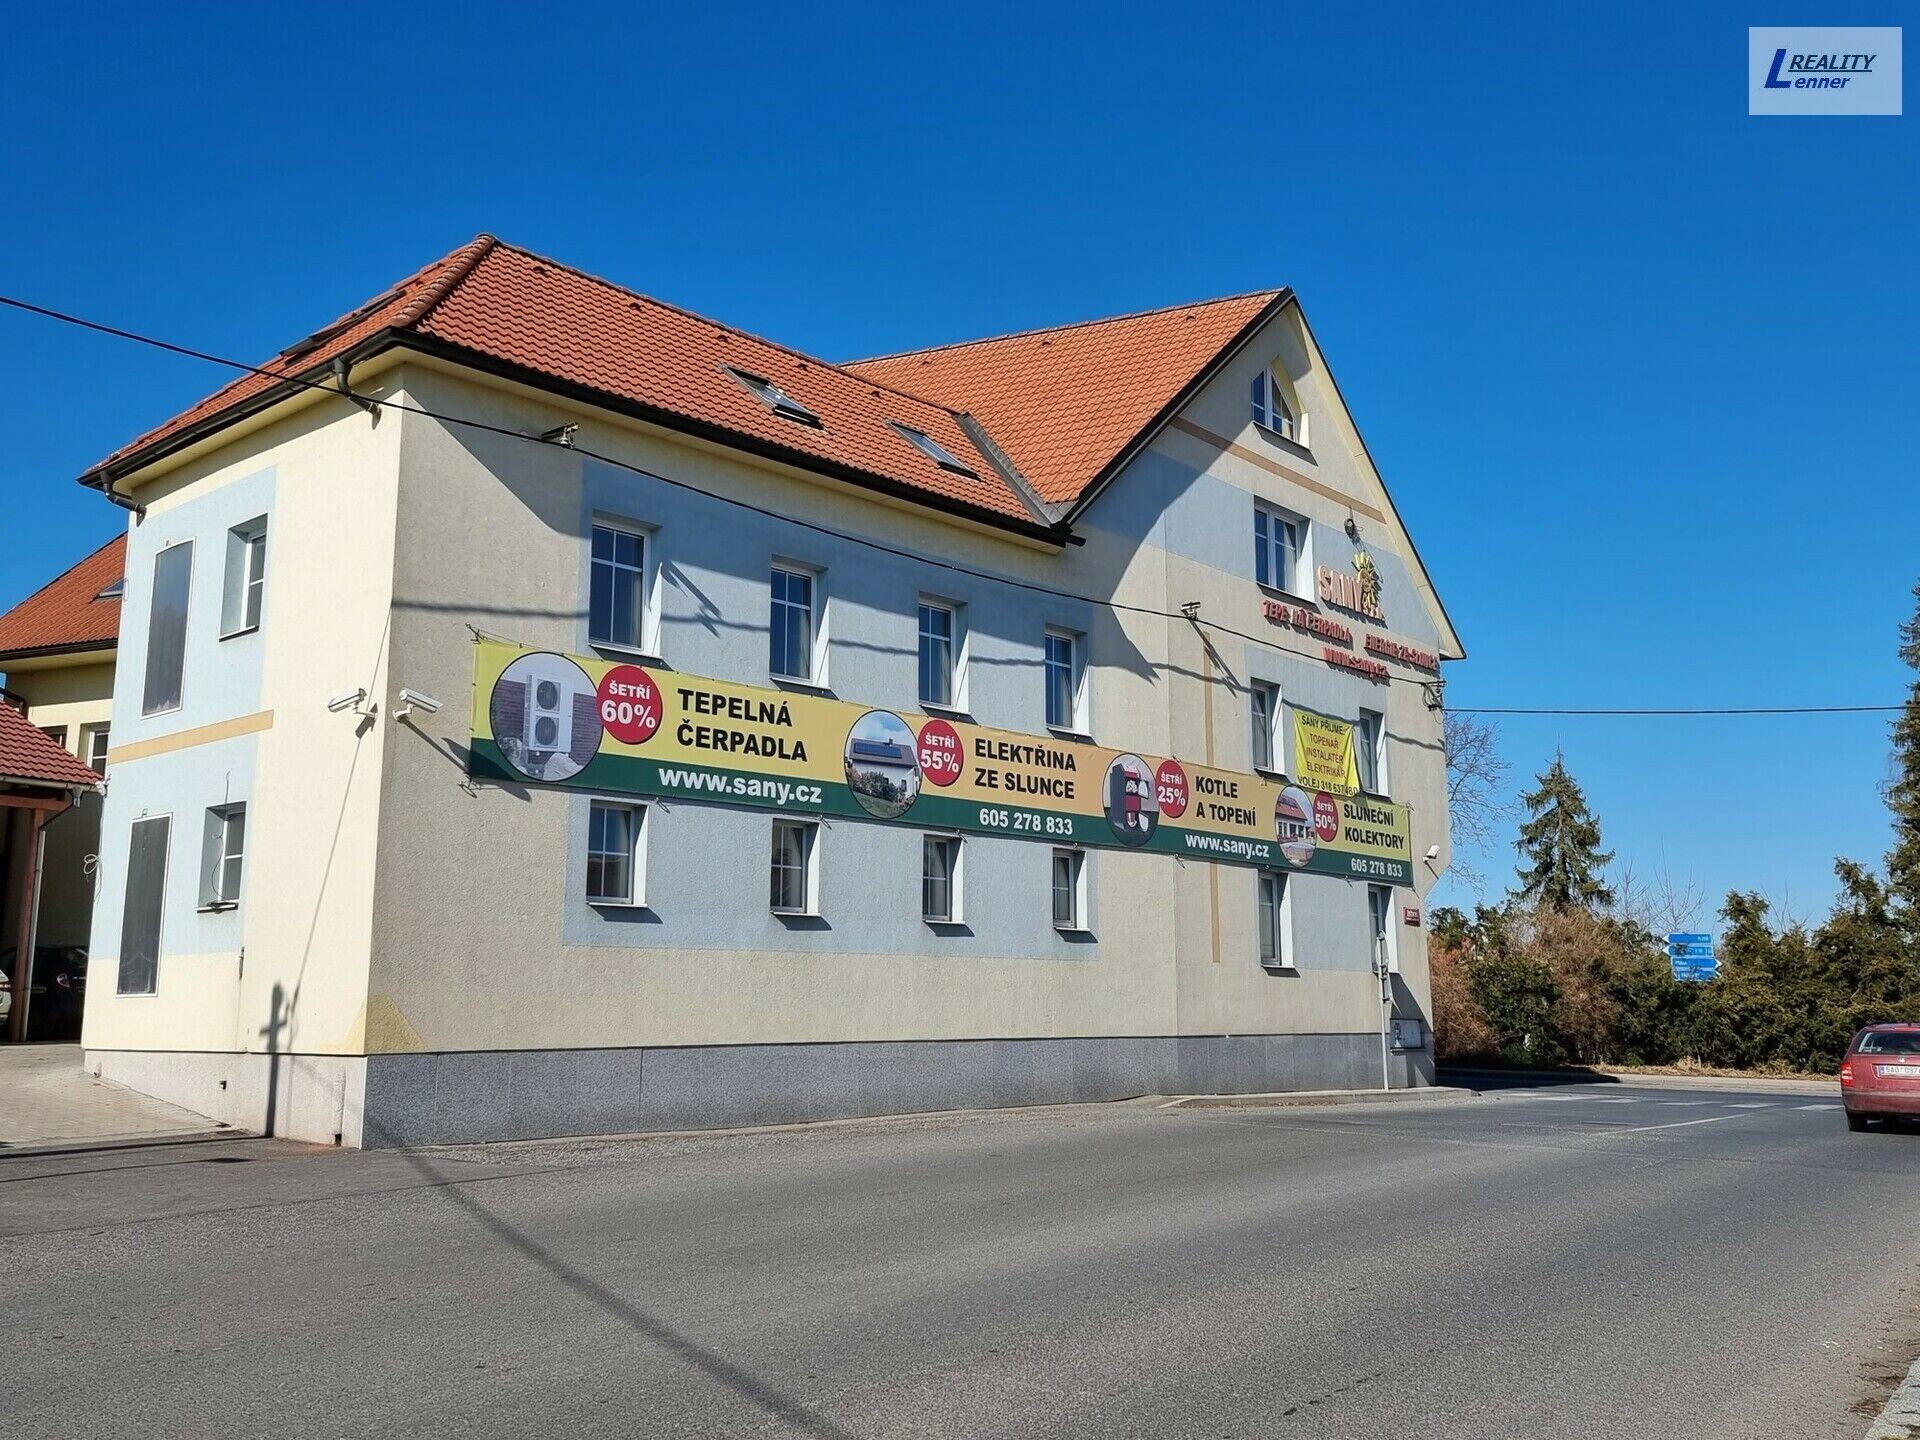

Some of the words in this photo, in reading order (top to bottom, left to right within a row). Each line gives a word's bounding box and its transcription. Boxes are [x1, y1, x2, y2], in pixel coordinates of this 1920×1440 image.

[1318, 565, 1361, 612] SANY
[609, 680, 650, 700] ŠETŘÍ
[601, 699, 656, 728] 60%
[677, 688, 793, 727] TEPELNÁ
[1301, 715, 1319, 728] SANY
[676, 719, 808, 762] ČERPADLA
[925, 732, 955, 748] ŠETŘÍ
[920, 749, 959, 773] 55%
[975, 738, 1076, 772] ELEKTŘINA
[659, 768, 822, 805] www.sany.cz
[975, 768, 999, 789] ZE
[1005, 772, 1075, 799] SLUNCE
[1161, 772, 1183, 785] ŠETŘÍ
[1196, 776, 1238, 799] KOTLE
[1297, 775, 1320, 789] VOLEJ
[1158, 786, 1186, 807] 25%
[1317, 801, 1334, 812] ŠETŘÍ
[979, 808, 1009, 827] 605
[1014, 812, 1042, 832] 278
[1046, 816, 1073, 835] 833
[1196, 801, 1206, 818] A
[1209, 804, 1256, 826] TOPENÍ
[1315, 813, 1337, 831] 50%
[1343, 803, 1394, 826] SLUNEČNÍ
[1185, 834, 1270, 859] www.sany.cz
[1344, 826, 1404, 850] KOLEKTORY
[1351, 858, 1368, 873] 605
[1369, 860, 1385, 875] 278
[1387, 863, 1403, 877] 833
